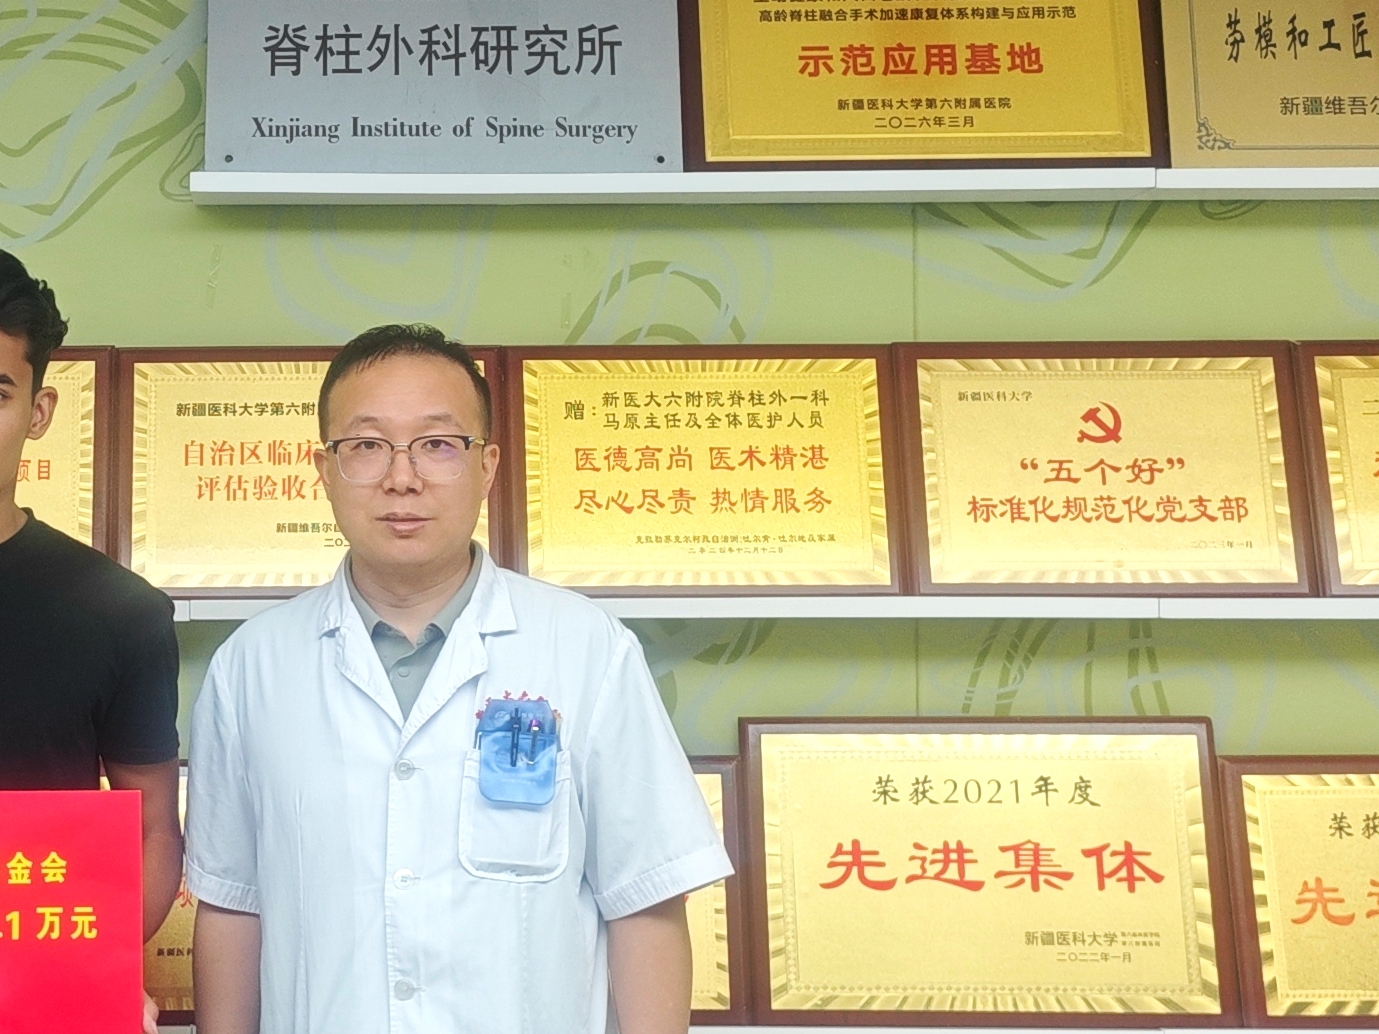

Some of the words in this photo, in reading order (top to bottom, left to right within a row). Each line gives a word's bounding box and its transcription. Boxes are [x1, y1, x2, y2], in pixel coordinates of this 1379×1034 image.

[758, 5, 1078, 23] 高龄脊柱融合手术加速康复体系构建与应用示范
[262, 23, 623, 77] 脊柱外科研究所
[1224, 8, 1372, 63] 劳模和工匠
[797, 42, 1044, 77] 示范应用基地
[837, 97, 1012, 111] 新疆医科大学第六附属医院
[251, 116, 340, 144] Xinjiang
[351, 116, 442, 138] Institute
[452, 116, 474, 138] of
[485, 116, 544, 144] Spine
[555, 116, 638, 144] Surgery
[601, 388, 830, 408] 新医大六附院脊柱外一科
[602, 410, 825, 430] 马原主任及全体医护人员
[574, 445, 694, 473] 医德高尚
[709, 443, 830, 472] 医术精湛
[573, 487, 697, 515] 尽心尽责
[709, 486, 833, 515] 热情服务
[966, 494, 1250, 524] 标准化规范化党支部
[871, 775, 1103, 807] 荣获2021年度
[819, 838, 1165, 893] 先进集体
[1290, 876, 1379, 926] 先
[1024, 931, 1119, 947] 新疆医科大学
